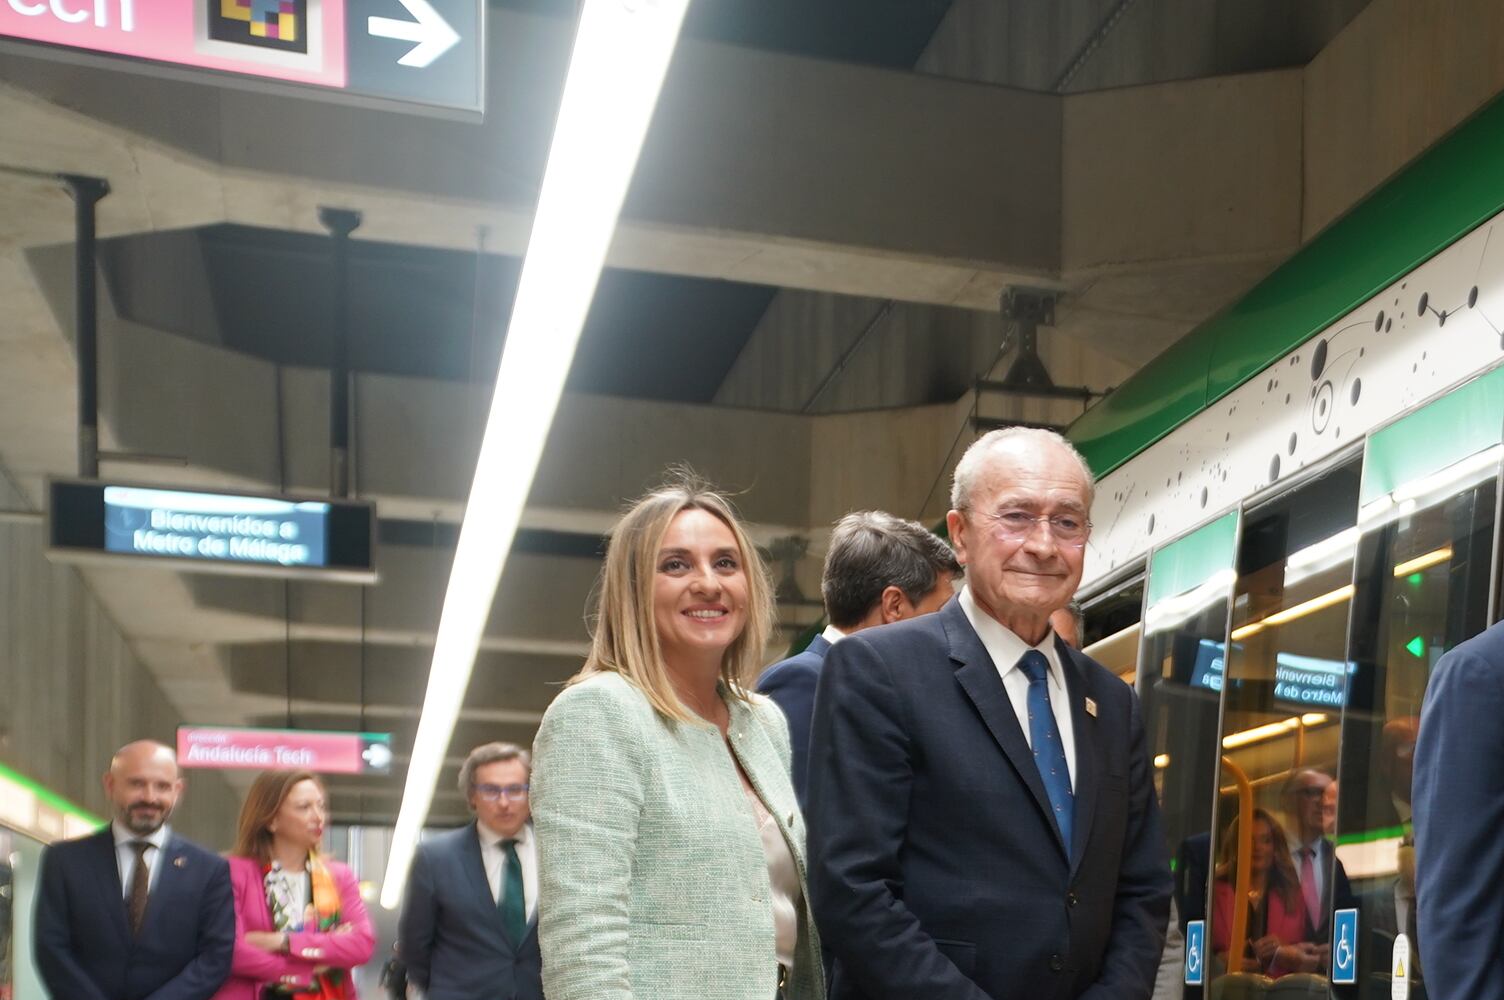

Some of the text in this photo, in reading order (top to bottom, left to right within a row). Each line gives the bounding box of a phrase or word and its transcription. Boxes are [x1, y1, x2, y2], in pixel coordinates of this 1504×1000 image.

[151, 508, 278, 540] Bienvenidos
[133, 529, 310, 567] Metro de Málaga
[187, 743, 314, 766] Andalucía Tech
